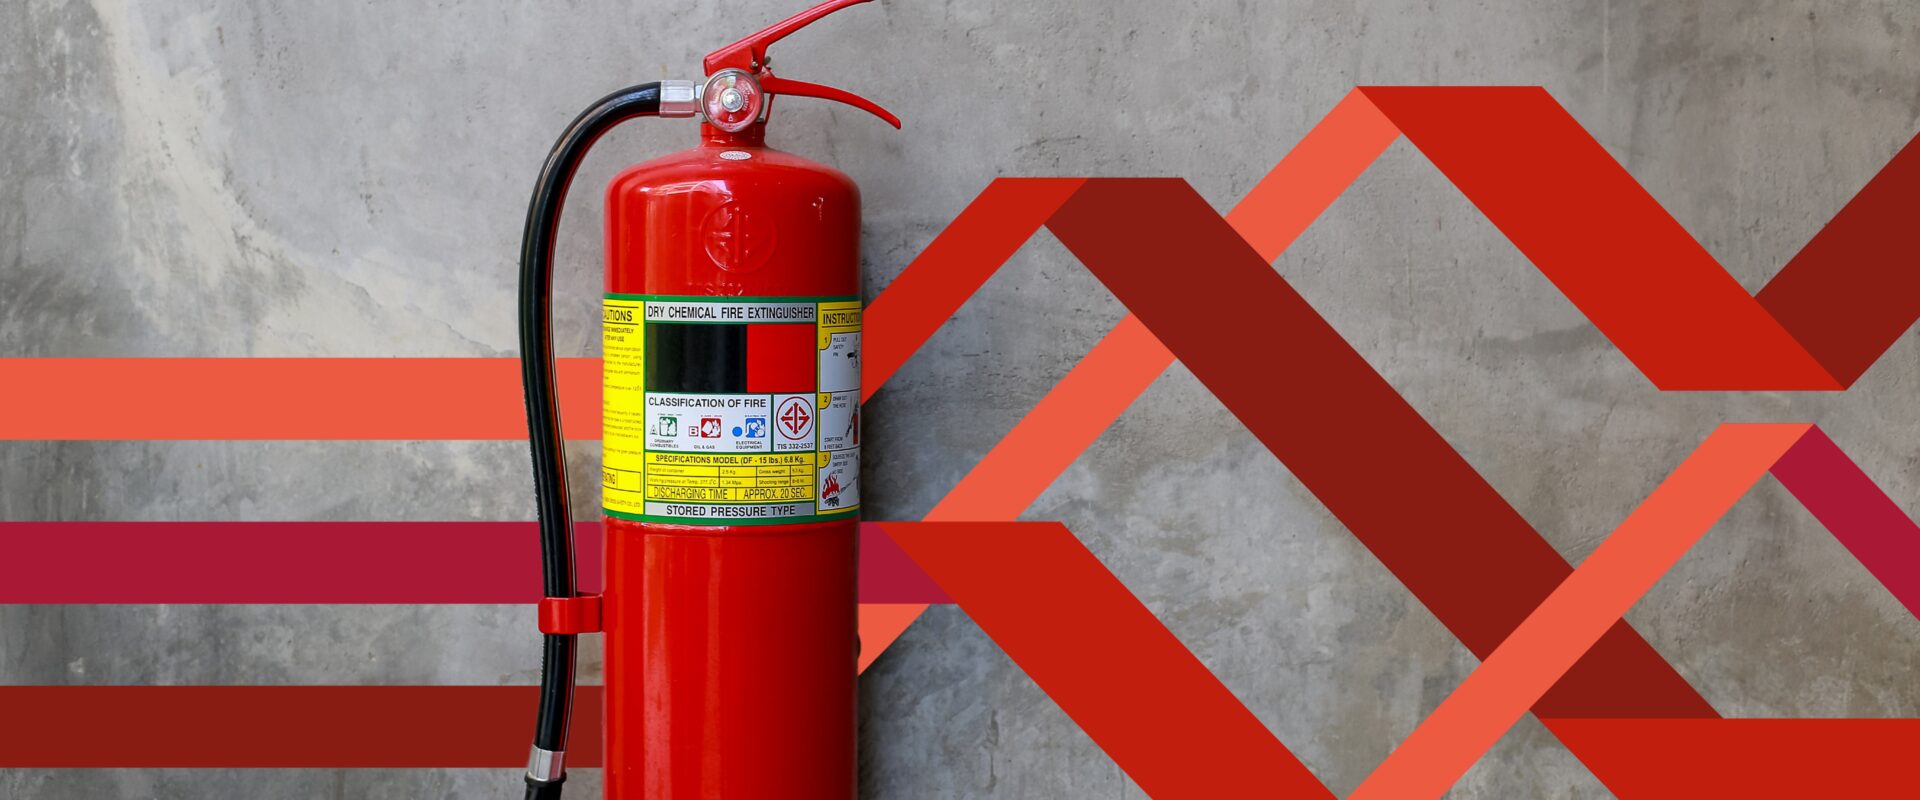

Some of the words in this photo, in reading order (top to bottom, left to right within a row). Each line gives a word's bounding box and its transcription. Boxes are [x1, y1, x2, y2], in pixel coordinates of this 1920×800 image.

[648, 306, 664, 317] DRY
[669, 306, 716, 318] CHEMICAL
[721, 307, 743, 318] FIRE
[748, 307, 814, 318] EXTINGUISHER
[649, 397, 724, 407] CLASSIFICATION
[728, 399, 741, 407] OF
[744, 399, 766, 407] FIRE
[655, 455, 710, 463] SPECIFICATIONS
[741, 456, 752, 464] (DF
[769, 456, 782, 464] lbs.)
[654, 487, 706, 499] DISCHARGING
[709, 488, 728, 499] TIME
[744, 488, 778, 499] APPROX.
[780, 488, 789, 498] 20
[791, 487, 806, 498] SEC.
[666, 505, 706, 515] STORED
[711, 506, 766, 516] PRESSURE
[772, 506, 795, 515] TYPE
